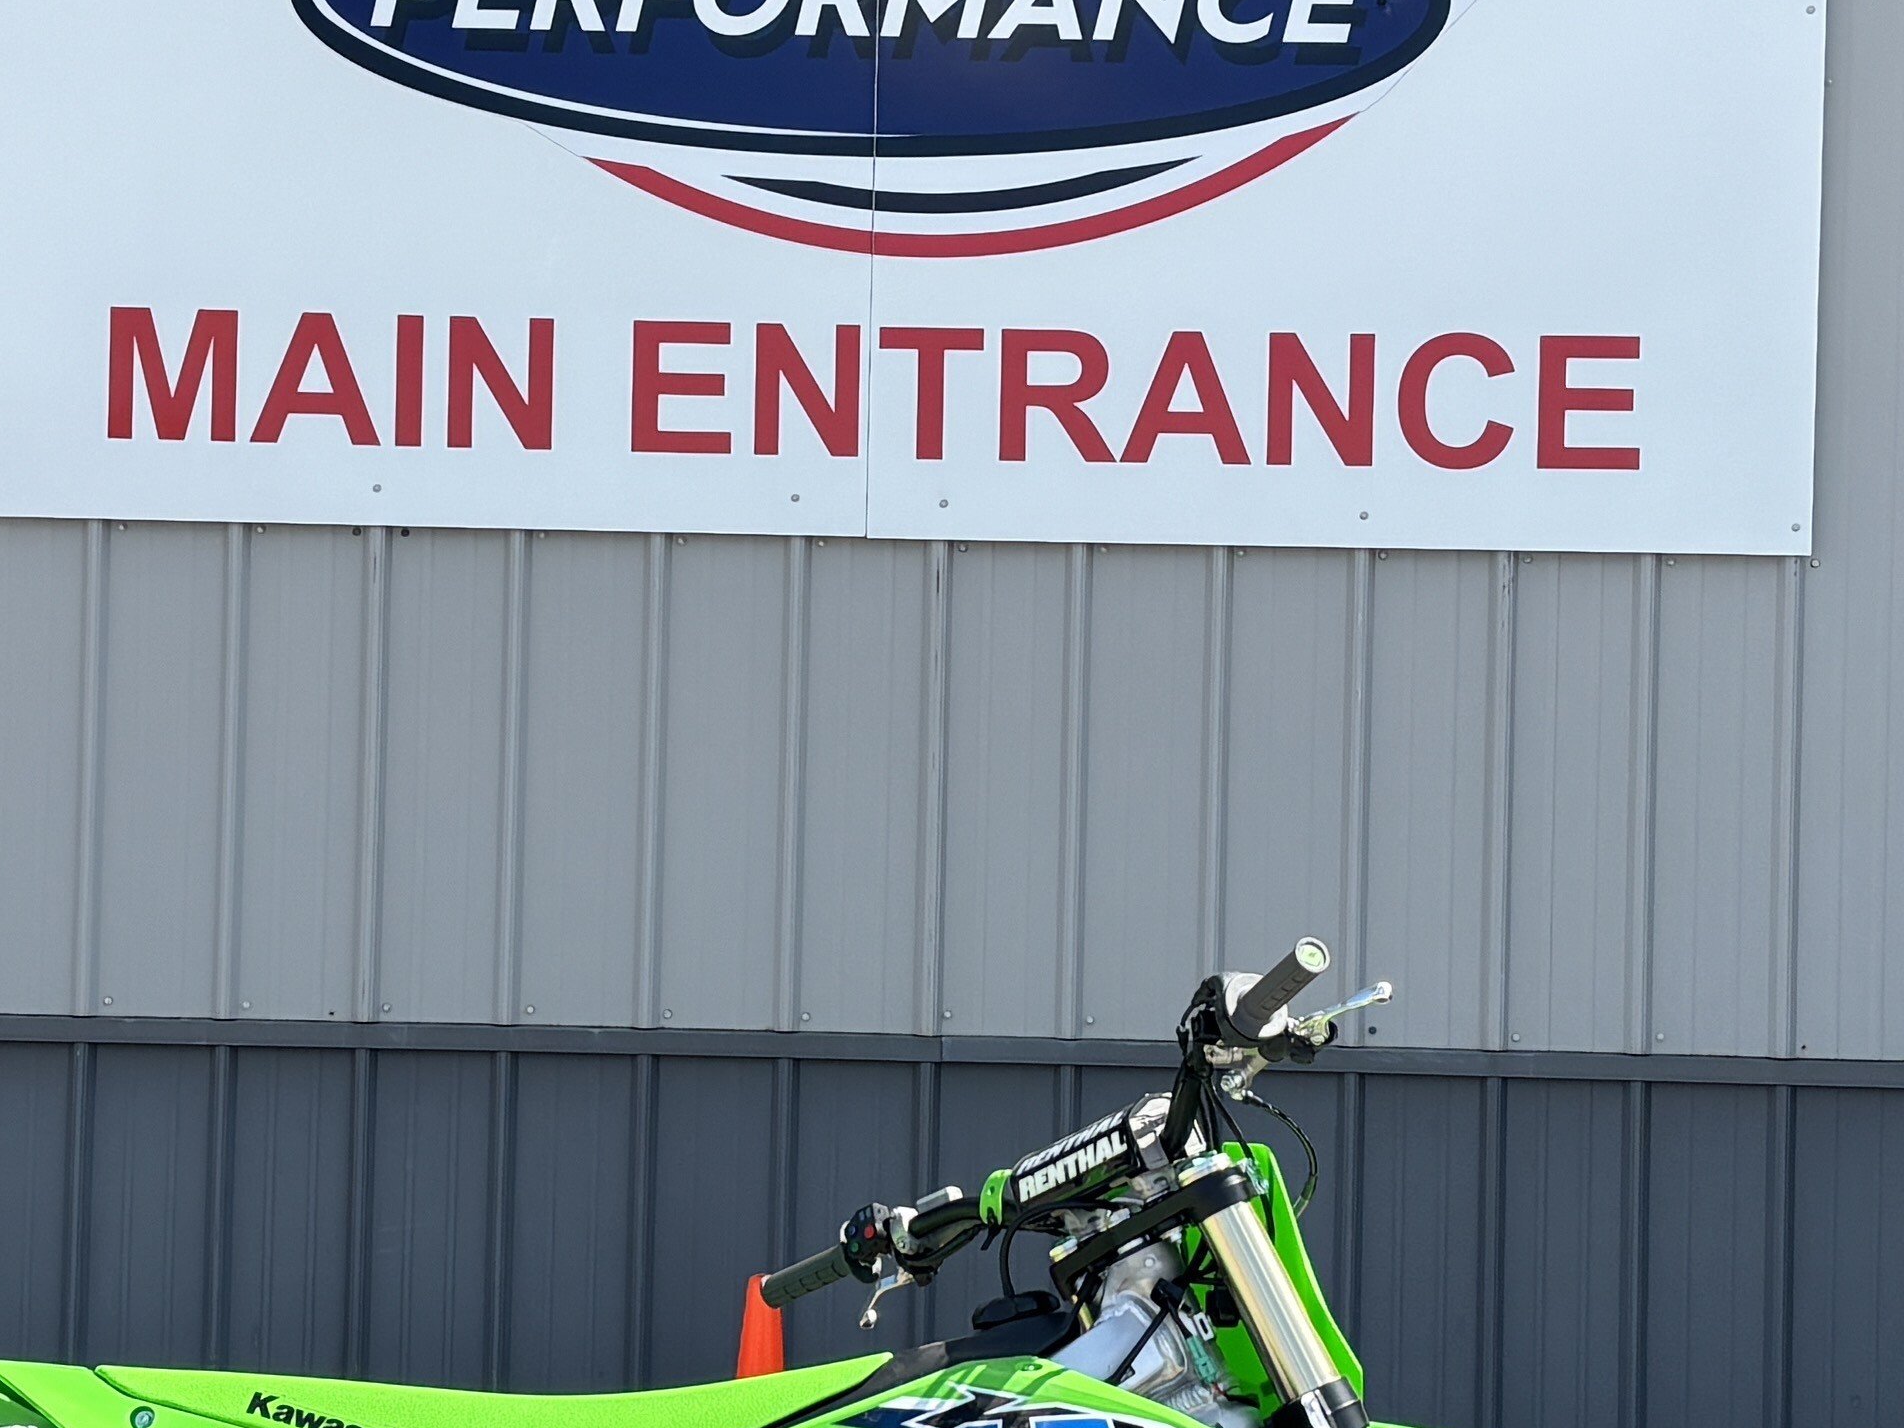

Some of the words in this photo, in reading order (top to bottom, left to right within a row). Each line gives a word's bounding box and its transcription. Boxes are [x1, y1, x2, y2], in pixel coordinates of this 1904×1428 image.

[107, 306, 554, 450] MAIN
[631, 320, 1640, 470] ENTRANCE
[1018, 1130, 1129, 1204] RENTHAL
